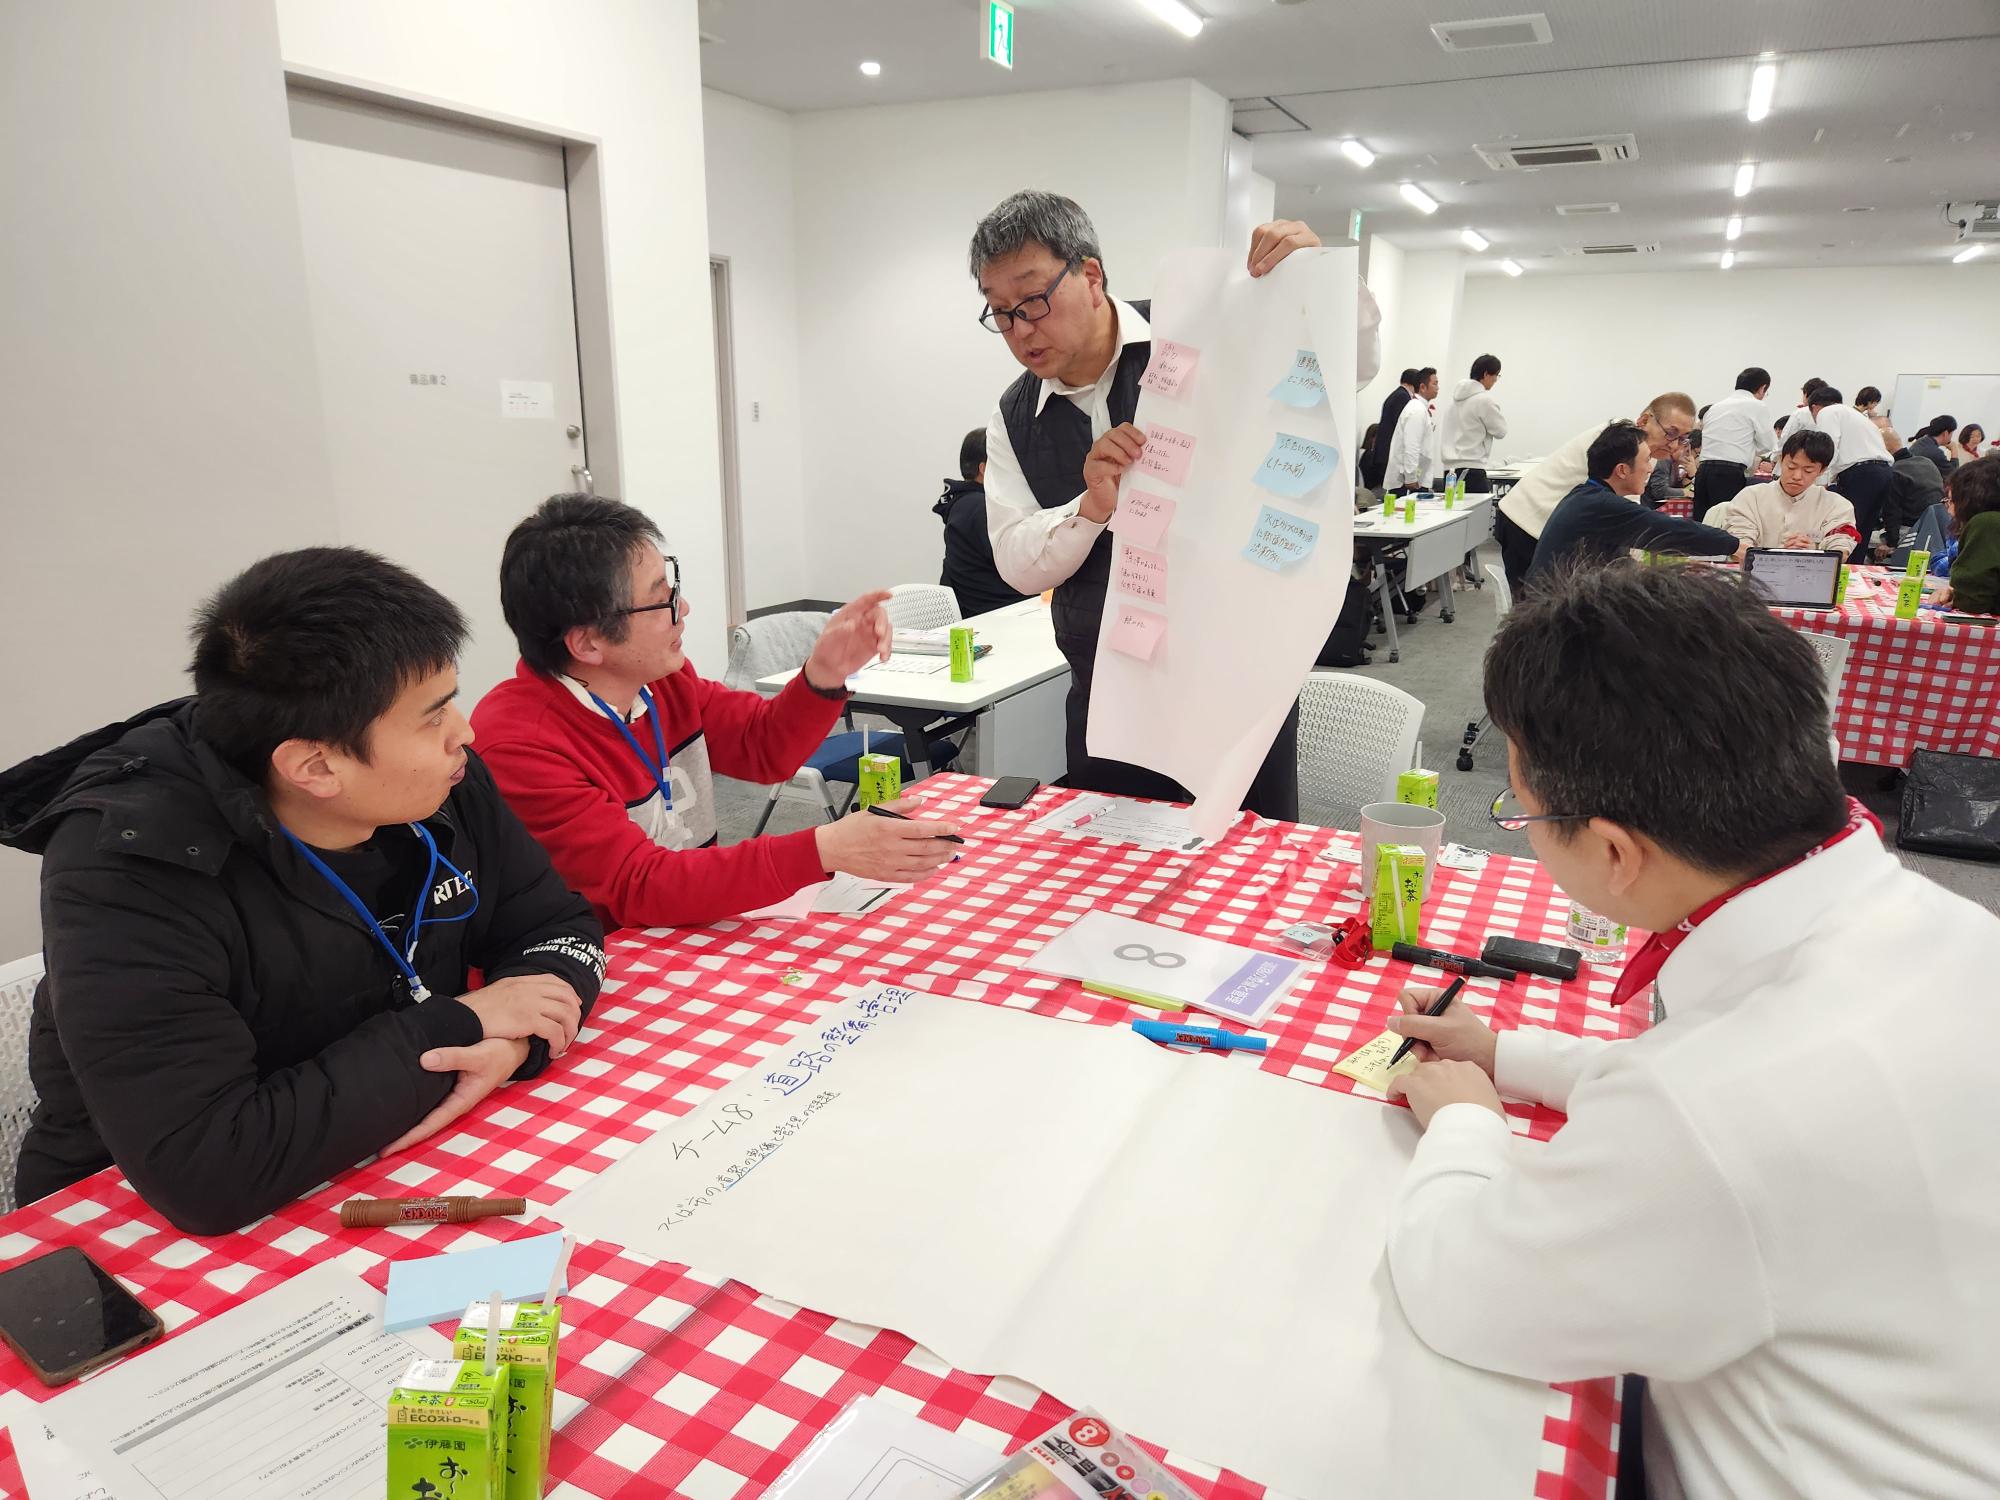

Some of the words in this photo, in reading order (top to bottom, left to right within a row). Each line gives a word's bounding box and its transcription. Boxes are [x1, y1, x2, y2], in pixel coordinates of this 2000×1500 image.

[560, 946, 593, 966] EVERY
[1113, 943, 1187, 969] 8
[400, 1207, 448, 1220] PROCKEY
[425, 1439, 466, 1451] 伊藤園
